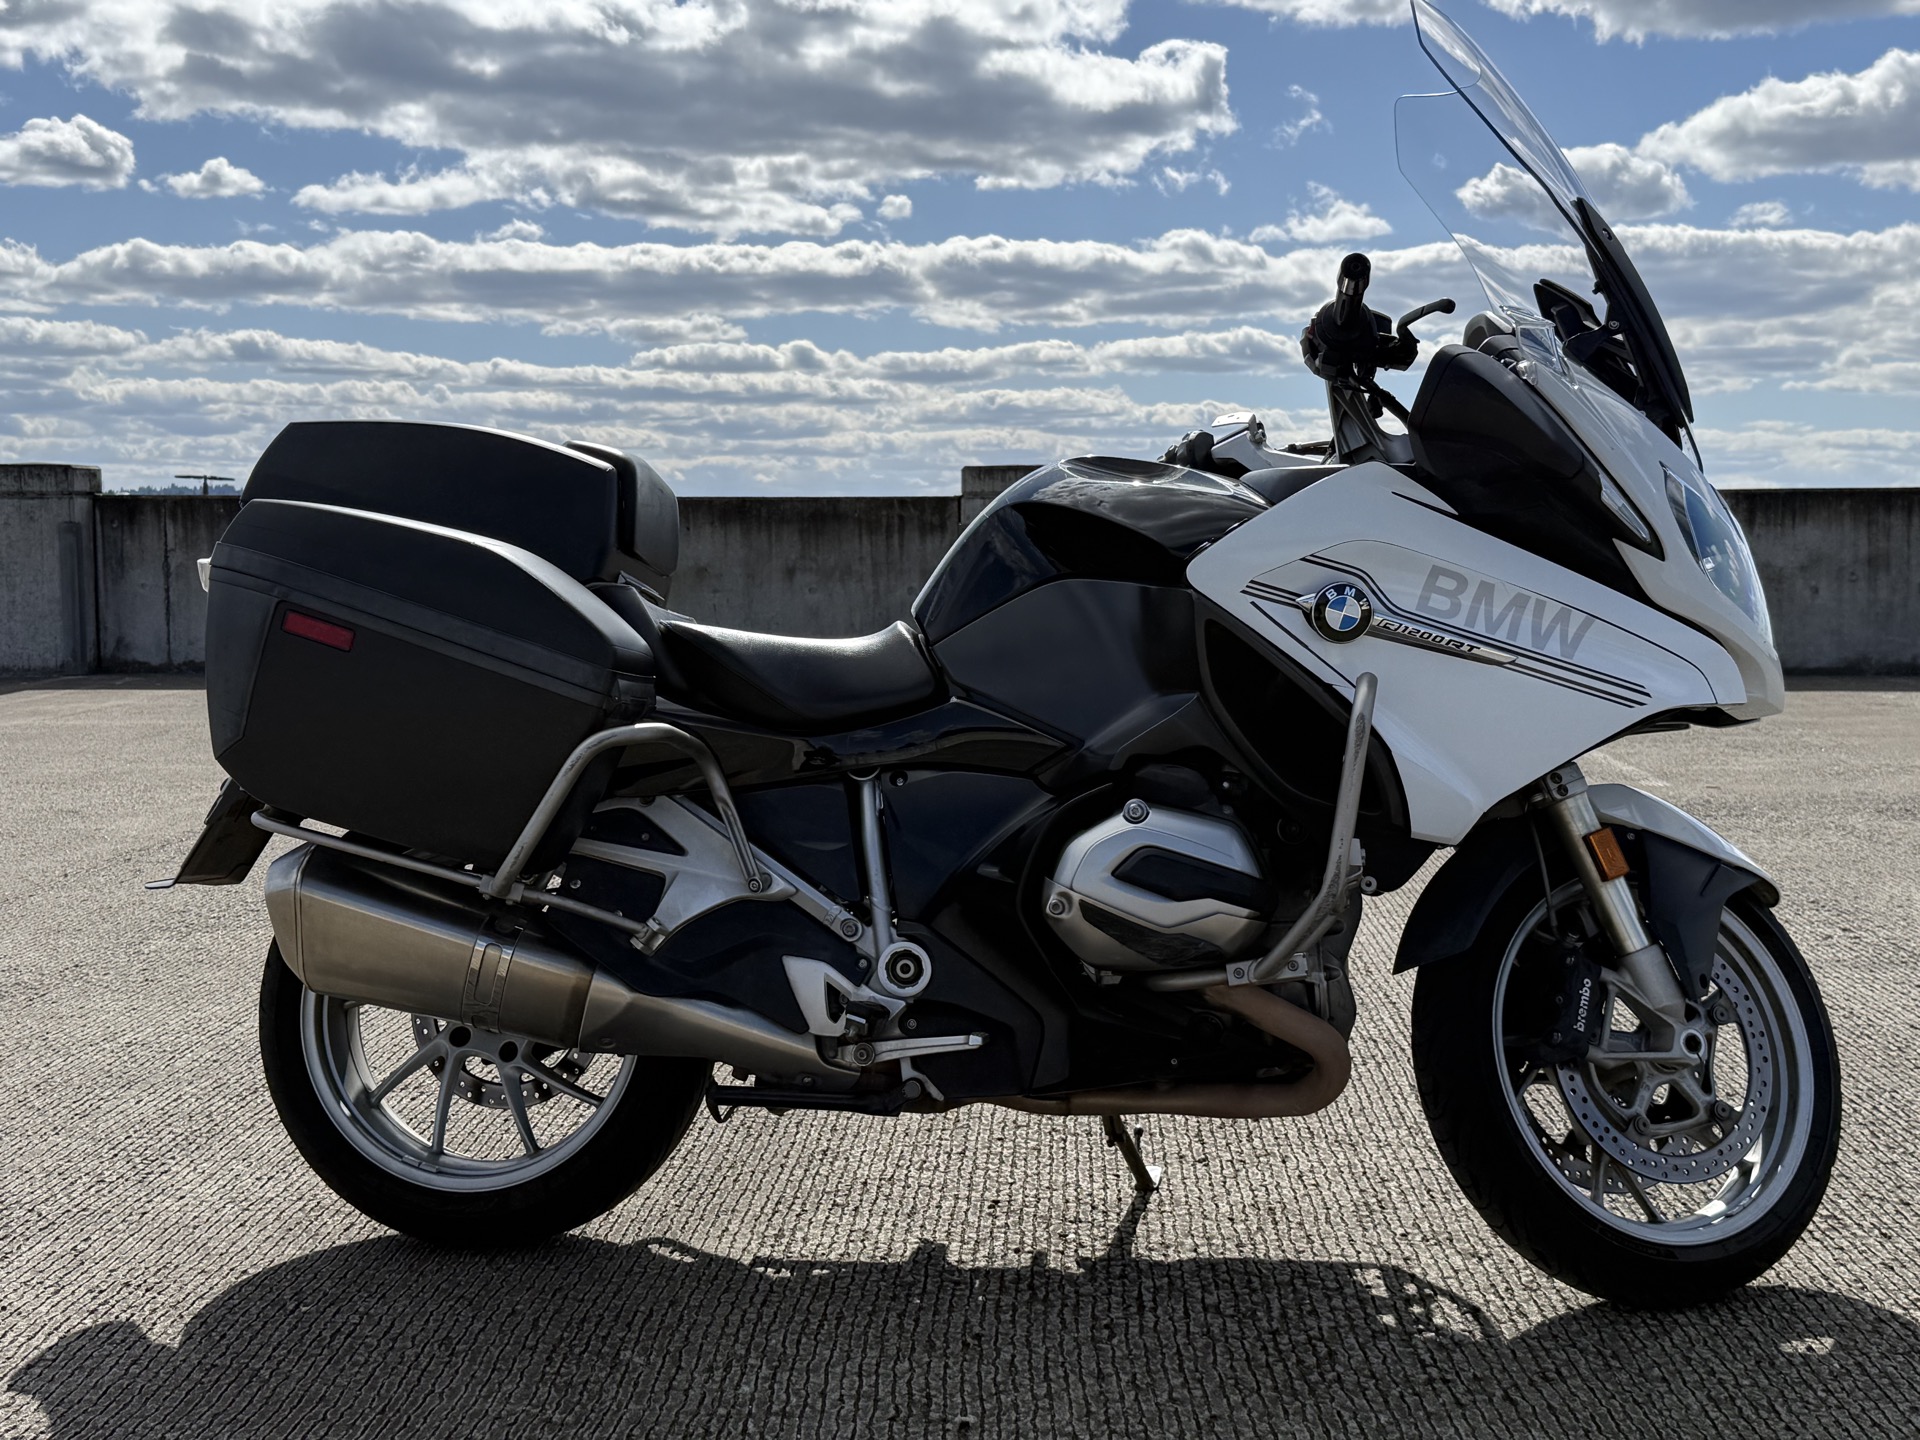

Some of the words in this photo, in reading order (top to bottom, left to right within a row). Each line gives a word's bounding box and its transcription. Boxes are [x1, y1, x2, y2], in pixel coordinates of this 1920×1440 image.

[1325, 586, 1370, 610] BMW
[1414, 564, 1599, 660] BMW
[1572, 978, 1592, 1032] brembo
